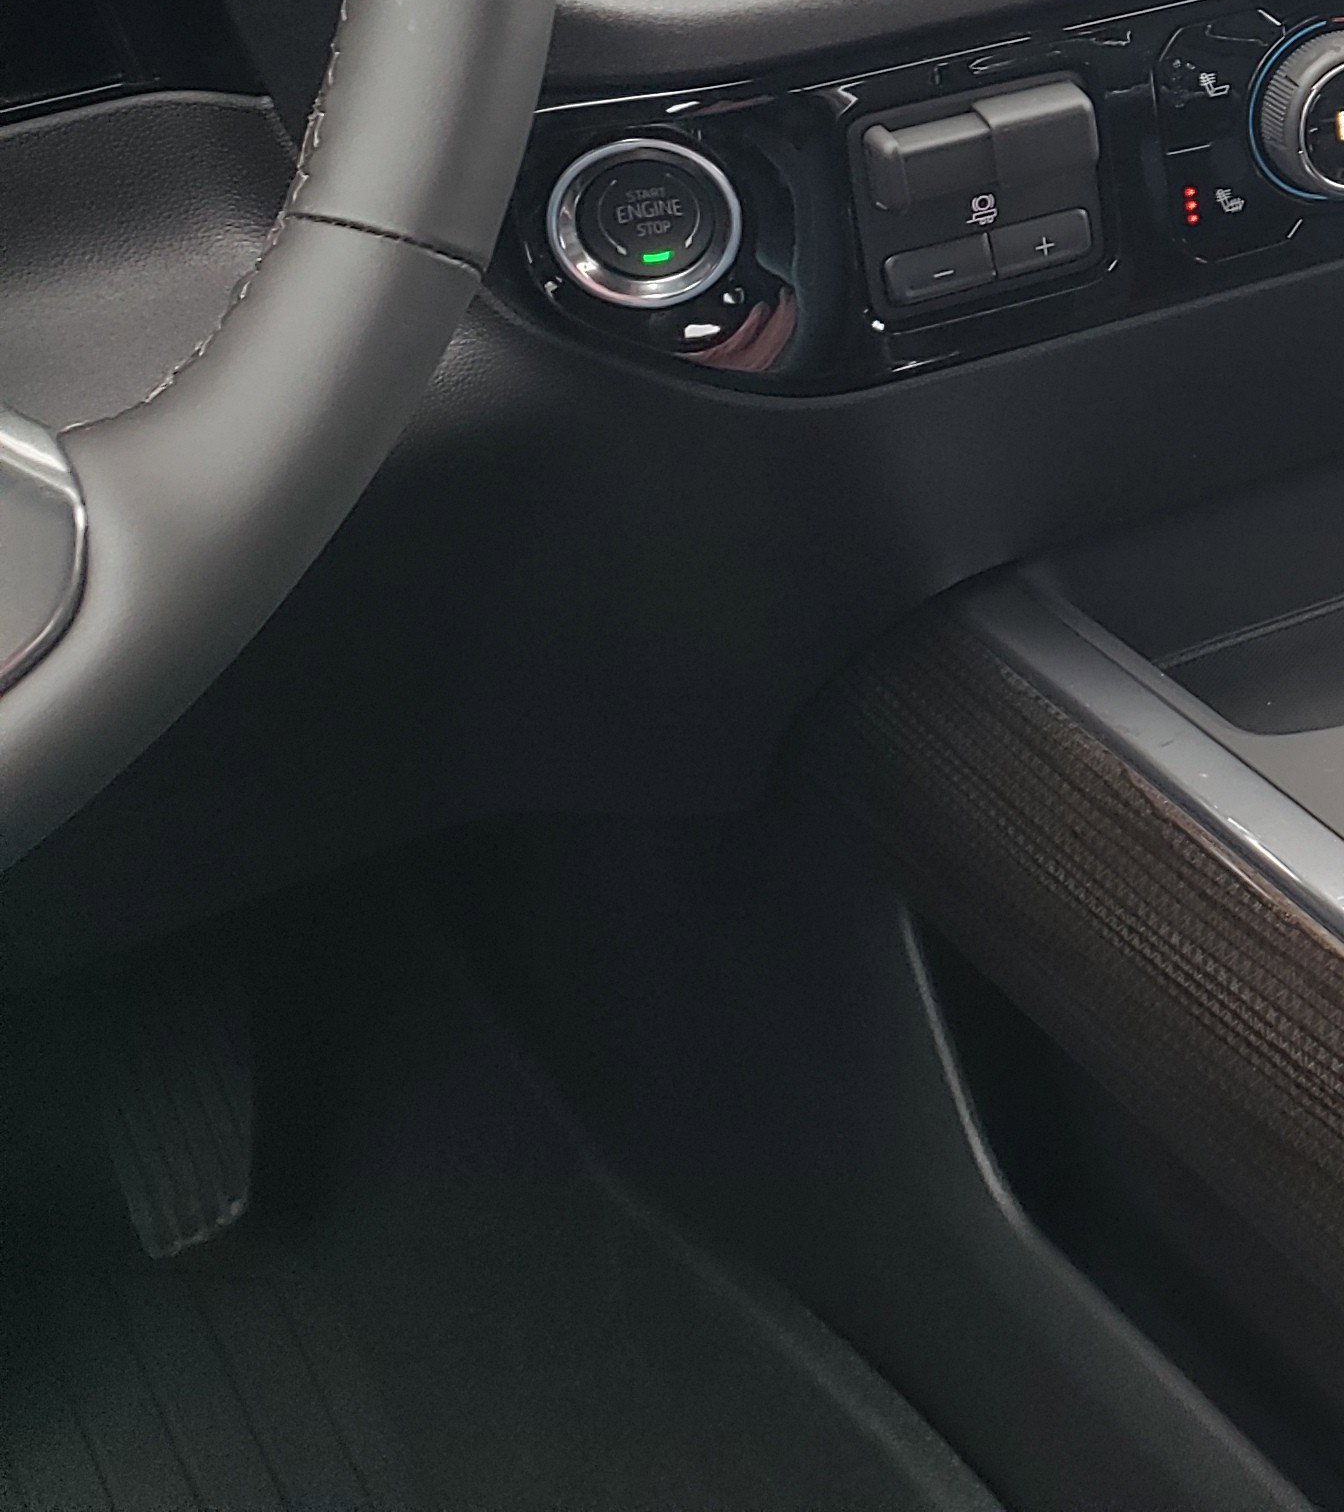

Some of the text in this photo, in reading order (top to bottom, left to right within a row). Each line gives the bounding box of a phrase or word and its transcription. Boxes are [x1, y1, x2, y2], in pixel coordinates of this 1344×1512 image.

[625, 187, 665, 203] START
[616, 199, 684, 224] ENGINE
[637, 220, 671, 237] STOP
